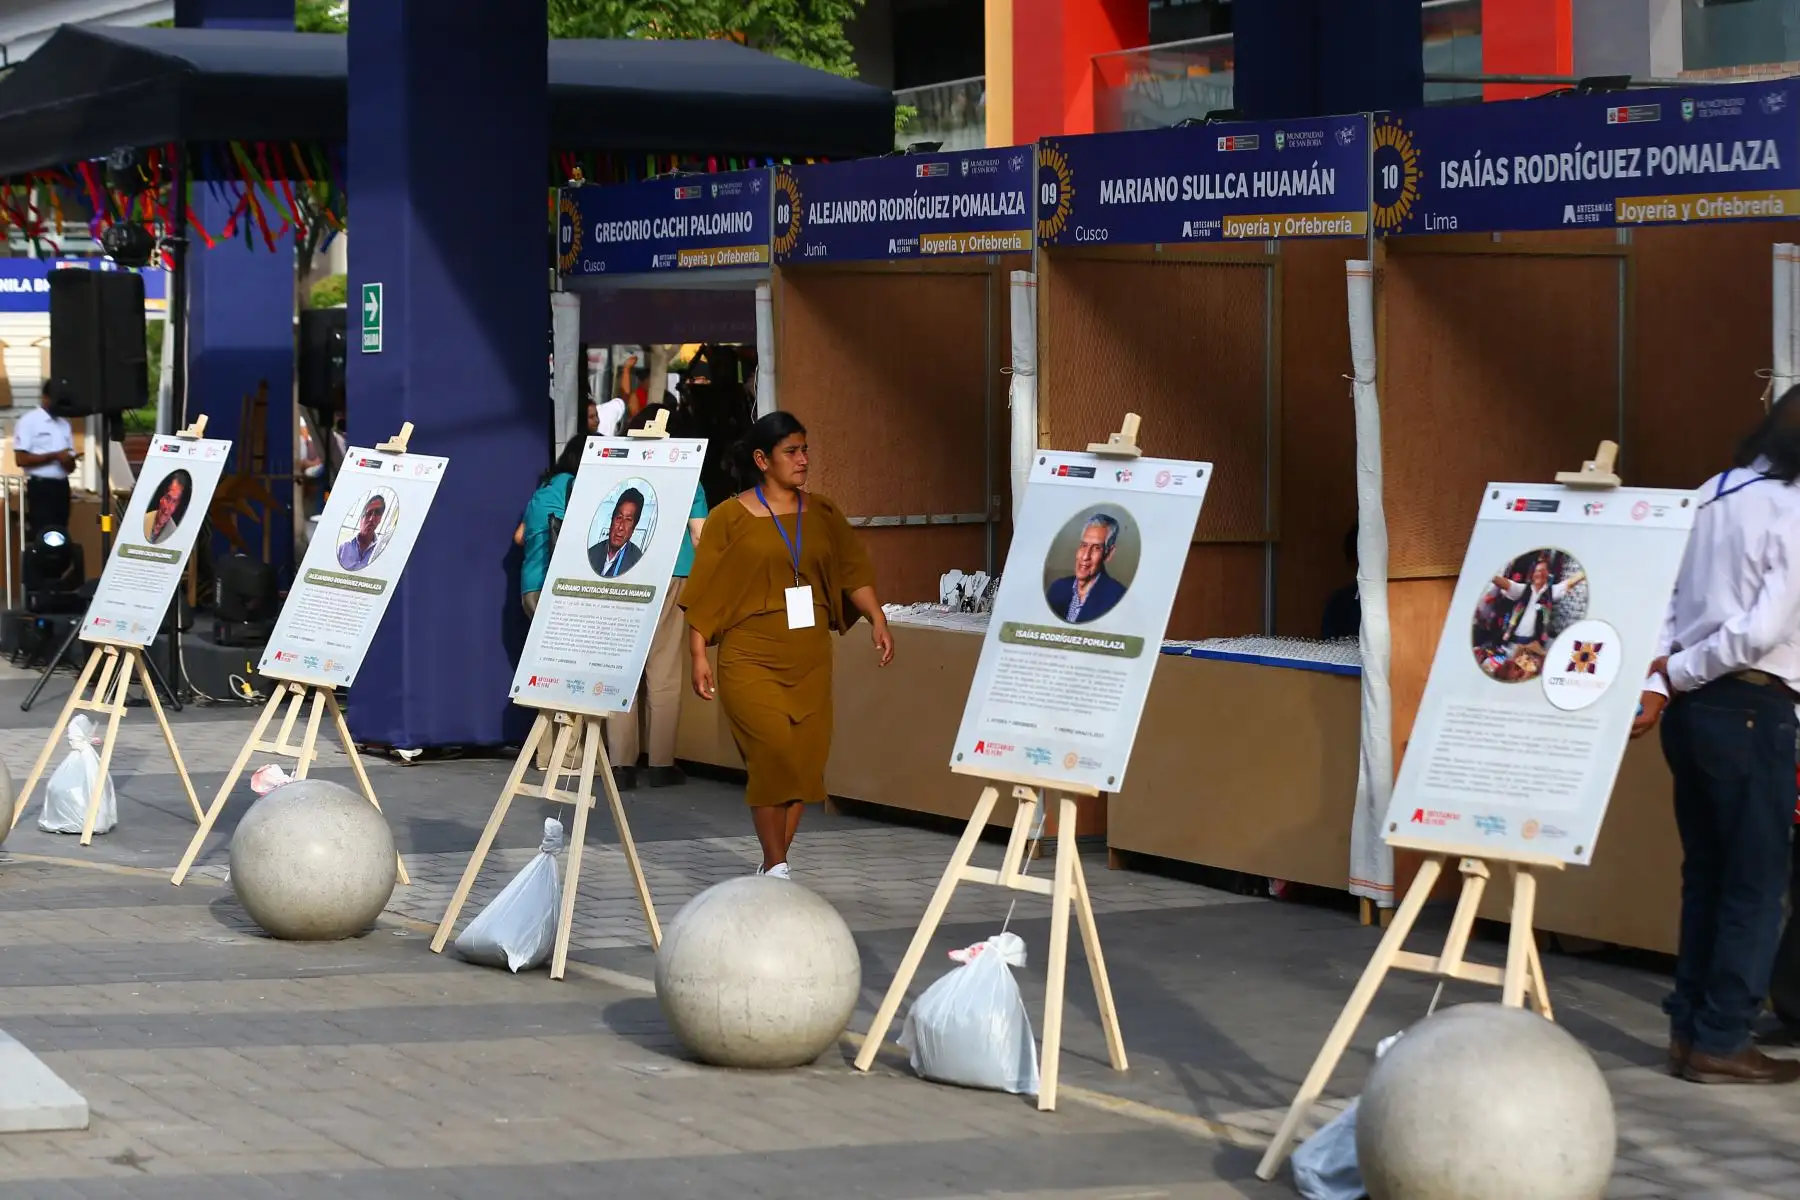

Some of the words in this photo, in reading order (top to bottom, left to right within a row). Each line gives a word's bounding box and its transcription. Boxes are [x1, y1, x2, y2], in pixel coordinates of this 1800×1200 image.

[1440, 150, 1509, 189] ISAÍAS
[1514, 142, 1641, 184] RODRÍGUEZ
[1646, 139, 1781, 176] POMALAZA
[1100, 176, 1178, 205] MARIANO
[1182, 172, 1249, 201] SULLCA
[1253, 160, 1335, 197] HUAMÁN
[1382, 165, 1398, 189] 10
[1041, 182, 1057, 205] 09
[777, 204, 789, 224] 08
[808, 199, 876, 225] ALEJANDRO
[879, 190, 950, 221] RODRÍGUEZ
[952, 191, 1025, 218] POMALAZA
[1617, 200, 1676, 223] Joyería
[1681, 204, 1692, 222] y
[1696, 195, 1784, 216] Orfebrería
[595, 219, 651, 243] GREGORIO
[653, 215, 688, 239] CACHI
[690, 211, 753, 236] PALOMINO
[1224, 218, 1270, 238] Joyería
[1273, 222, 1282, 238] y
[1285, 216, 1352, 234] Orfebrería
[1424, 213, 1458, 230] Lima
[562, 226, 572, 243] 07
[921, 235, 957, 254] Joyería
[960, 240, 966, 254] y
[968, 233, 1022, 250] Orfebrería
[1075, 226, 1109, 241] Cusco
[678, 252, 707, 268] Joyería
[709, 254, 715, 267] y
[717, 248, 760, 263] Orfebrería
[804, 241, 828, 257] Junín
[584, 259, 605, 272] Cusco
[556, 583, 580, 592] MARIANO
[581, 585, 609, 594] VICITACIÓN
[609, 588, 628, 596] SULLCA
[628, 589, 652, 598] HUAMÁN
[1015, 629, 1039, 640] ISAÍAS
[1040, 632, 1081, 645] RODRÍGUEZ
[1083, 637, 1125, 650] POMALAZA
